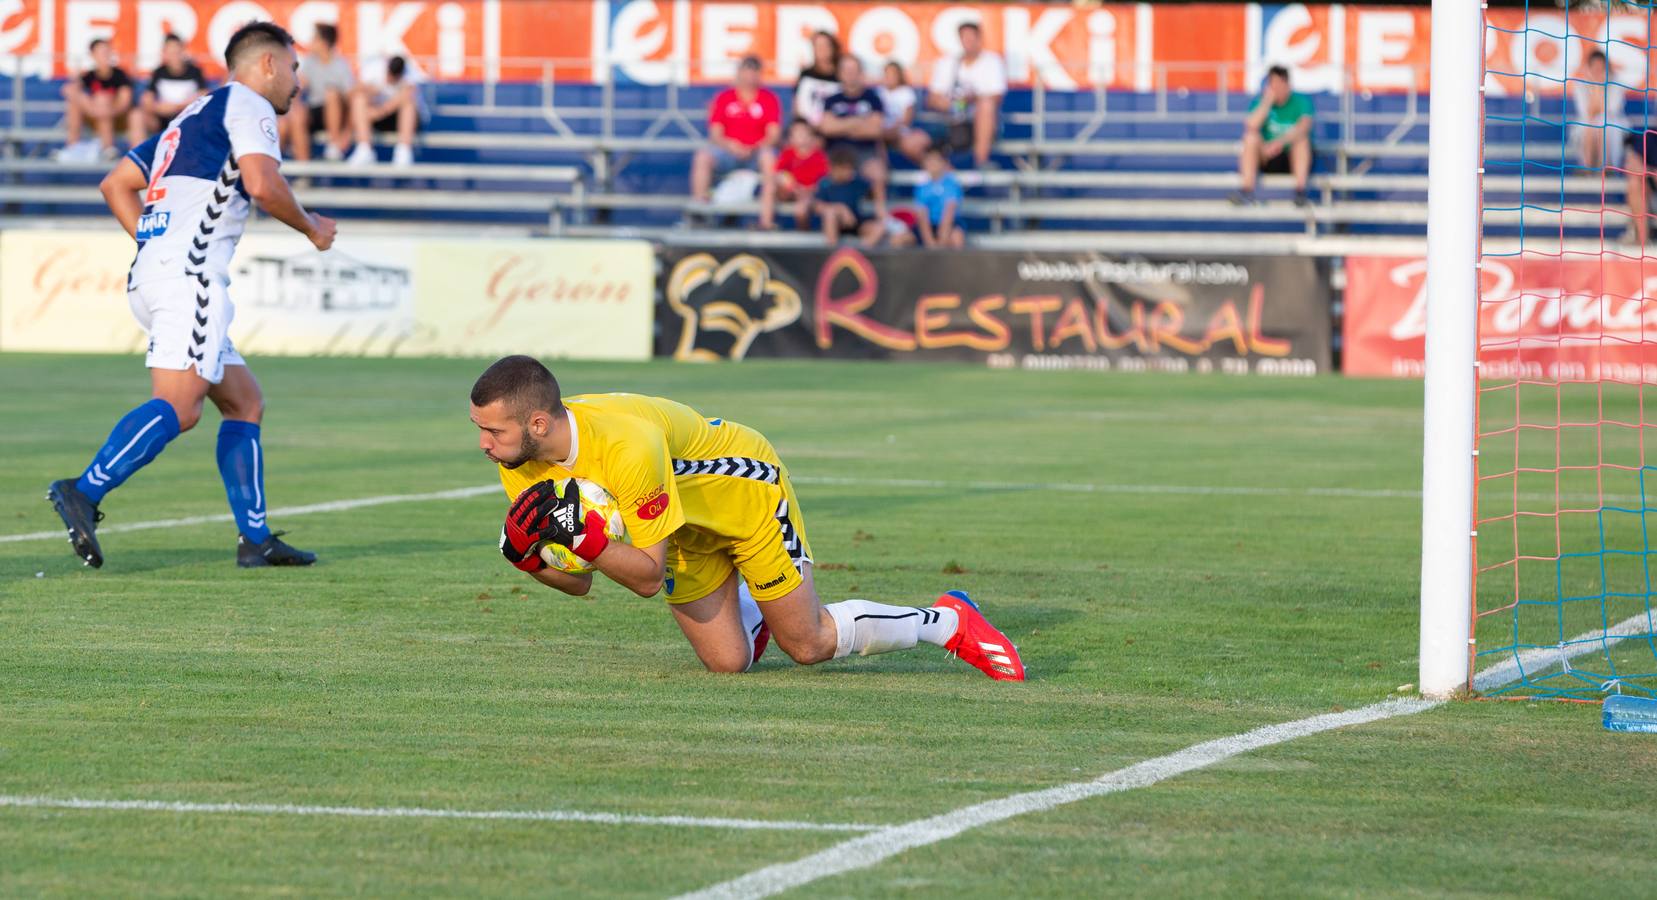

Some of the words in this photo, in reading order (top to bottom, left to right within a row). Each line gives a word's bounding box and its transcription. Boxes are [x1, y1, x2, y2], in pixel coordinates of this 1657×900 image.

[146, 128, 180, 205] 2
[567, 503, 575, 533] adidas
[754, 572, 787, 591] hummel
